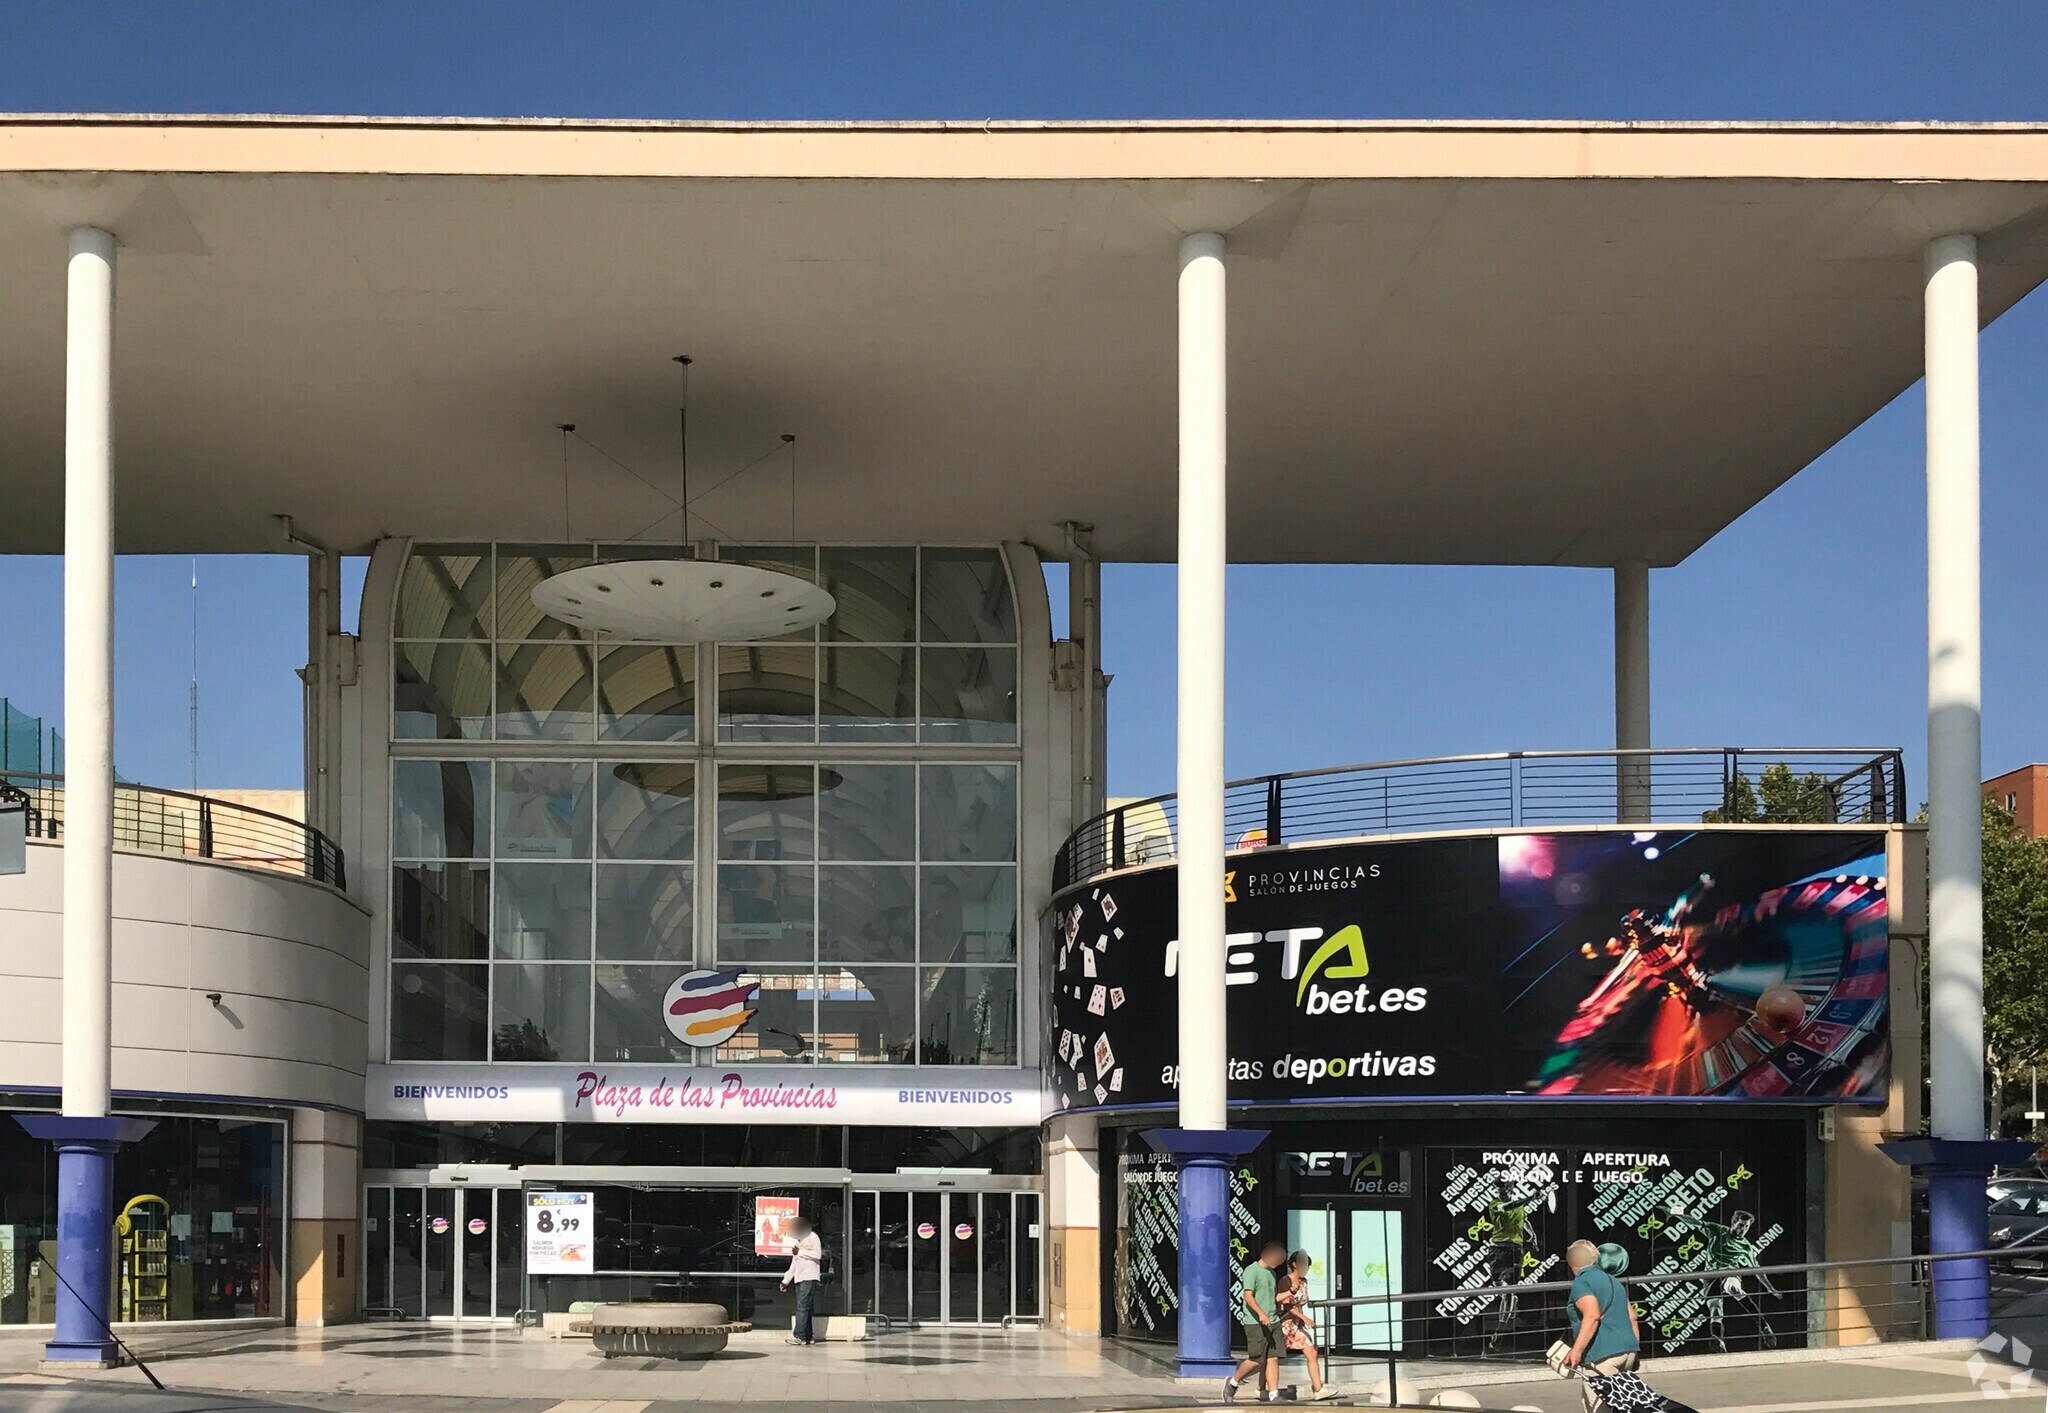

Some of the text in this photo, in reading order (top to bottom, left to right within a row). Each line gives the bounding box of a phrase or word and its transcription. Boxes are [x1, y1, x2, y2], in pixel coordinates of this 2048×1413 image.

[1249, 864, 1381, 888] PROVINCIAS
[1249, 880, 1358, 897] SALÓN DE JUEGOS
[1164, 924, 1370, 1008] ETA
[1305, 983, 1428, 1016] bet.es
[1806, 1026, 1838, 1045] 12
[1272, 1050, 1437, 1085] deportivas
[1786, 1051, 1806, 1066] 8
[393, 1084, 509, 1100] BIENVENIDOS
[575, 1071, 838, 1118] Plaza de las Provincias
[898, 1090, 1013, 1104] BIENVENIDOS
[1279, 1151, 1382, 1188] RETA
[1445, 1163, 1466, 1181] Ocio
[1482, 1149, 1671, 1167] PRÓXIMA APERTURA
[1354, 1177, 1409, 1193] bet.es
[1440, 1167, 1478, 1202] EQUIPO
[1445, 1167, 1501, 1217] Apuestas
[1592, 1170, 1644, 1184] JUEGO
[1664, 1167, 1716, 1210] RETO
[1229, 1196, 1262, 1236] EQUIPO
[1592, 1177, 1654, 1232] Apuestas
[1620, 1169, 1685, 1228] DIVERSIÓN
[1140, 1201, 1164, 1244] EQUIPO
[1228, 1212, 1249, 1240] estas
[1432, 1236, 1472, 1272] TENIS
[1138, 1257, 1161, 1298] RETO
